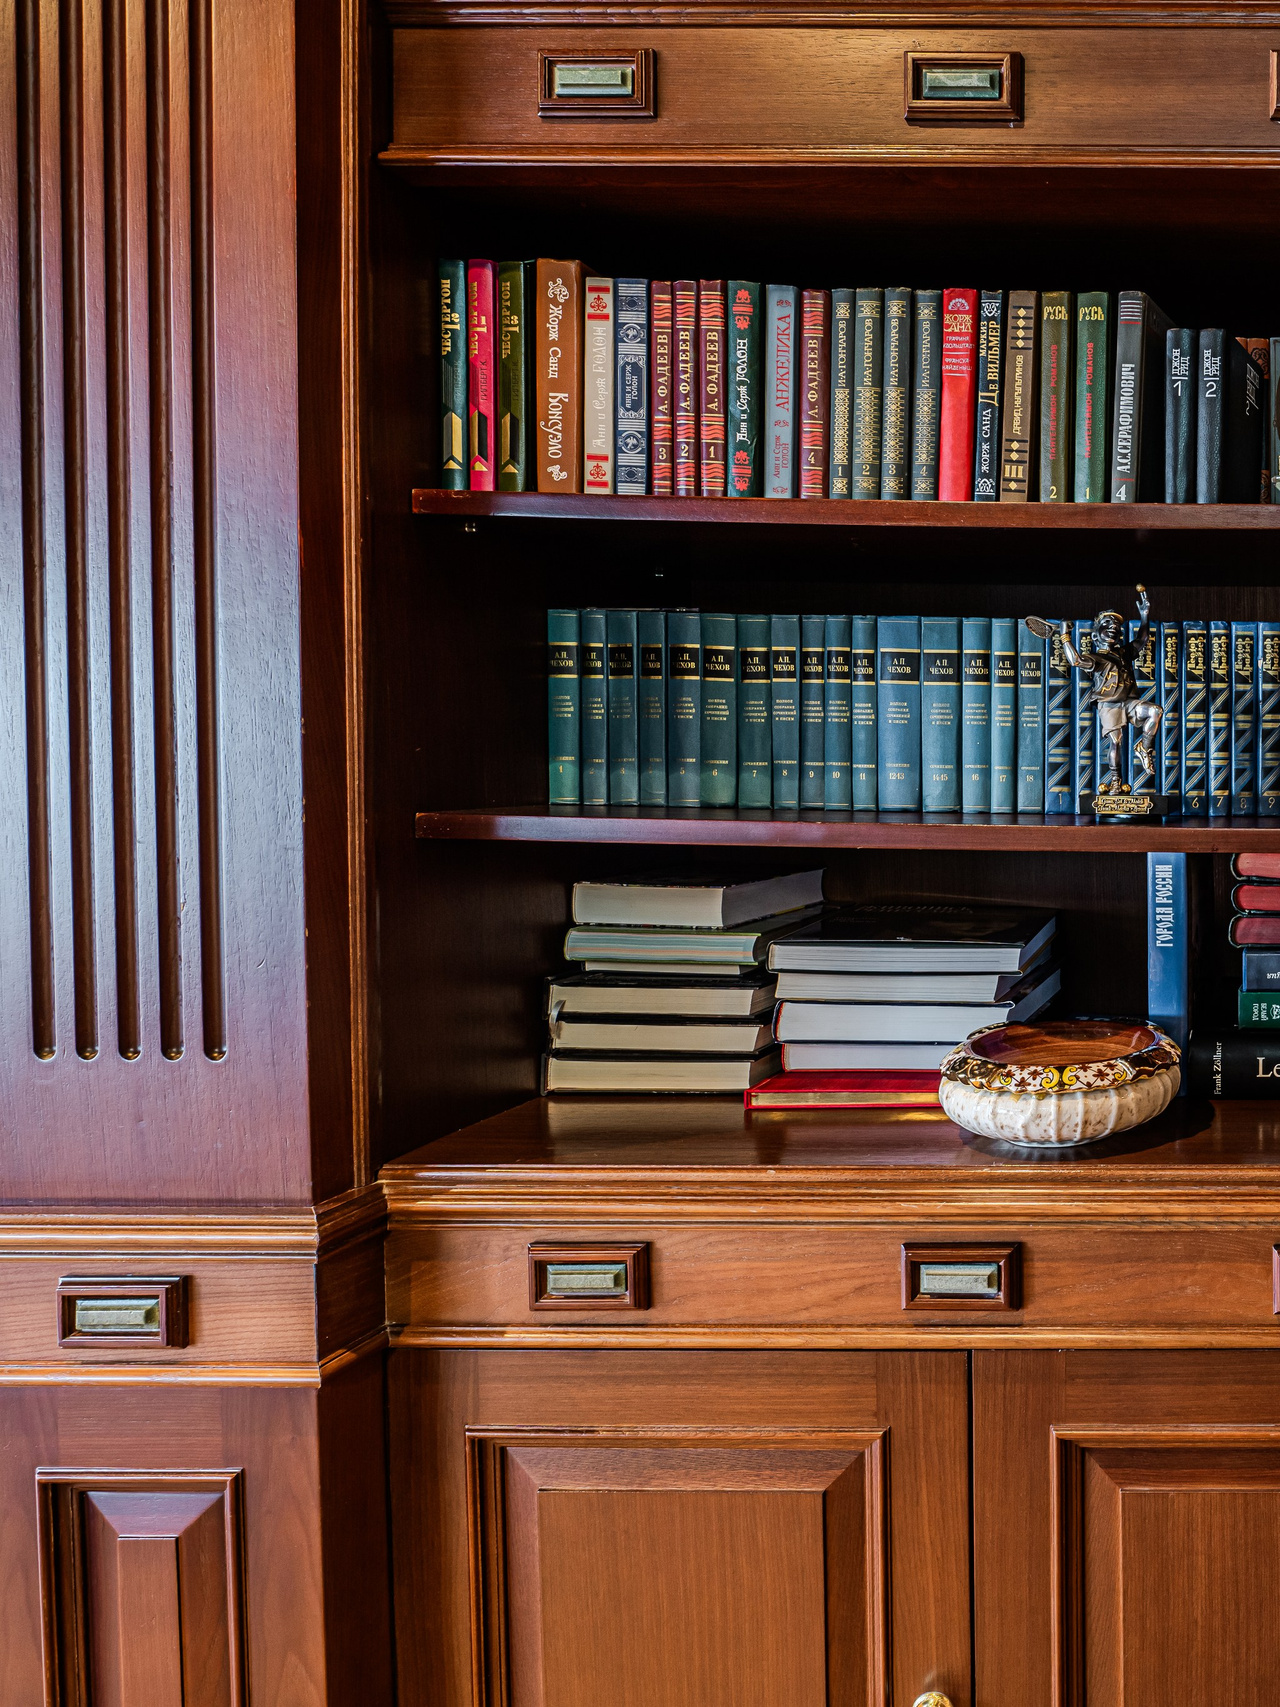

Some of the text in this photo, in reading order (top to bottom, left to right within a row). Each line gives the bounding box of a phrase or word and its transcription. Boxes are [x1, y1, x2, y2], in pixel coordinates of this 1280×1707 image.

[944, 314, 973, 323] ЖОРЖ
[979, 321, 988, 357] МАРКИЗ
[987, 320, 1000, 381] ВИЛЬМЕР
[656, 333, 671, 398] ФАДЕЕВ
[679, 331, 693, 394] ФАДЕЕВ
[706, 331, 721, 395] ФАДЕЕВ
[775, 313, 791, 412] АНЖЕЛИКА
[1086, 342, 1095, 386] РОМАНОВ
[1172, 348, 1181, 375] ДЖОН
[1180, 356, 1190, 376] РИД
[1203, 349, 1211, 376] ДЖОН
[1211, 356, 1221, 376] РИД
[808, 339, 822, 402] ФАДЕЕВ
[1173, 380, 1182, 397] 1
[1205, 381, 1217, 397] 2
[981, 408, 992, 474] ЖОРЖ САНД
[658, 447, 667, 460] 3
[681, 445, 689, 457] 2
[709, 446, 715, 458] 1
[807, 452, 815, 464] 4
[837, 466, 843, 477] 1
[862, 464, 870, 475] 2
[888, 464, 896, 475] 3
[919, 465, 928, 476] 4
[1049, 486, 1058, 499] 2
[1085, 487, 1090, 500] 1
[1115, 484, 1127, 501] 4
[773, 664, 795, 672] ЧЕХОВ
[887, 666, 912, 674] ЧЕХОВ
[929, 667, 954, 675] ЧЕХОВ
[964, 667, 989, 675] ЧЕХОВ
[994, 669, 1015, 677] ЧЕХОВ
[832, 771, 841, 779] 10
[1191, 797, 1200, 808] 6
[1217, 797, 1224, 807] 7
[1155, 864, 1176, 947] ГОРОДА РОССИИ
[1213, 1042, 1222, 1095] Frank Zöllner
